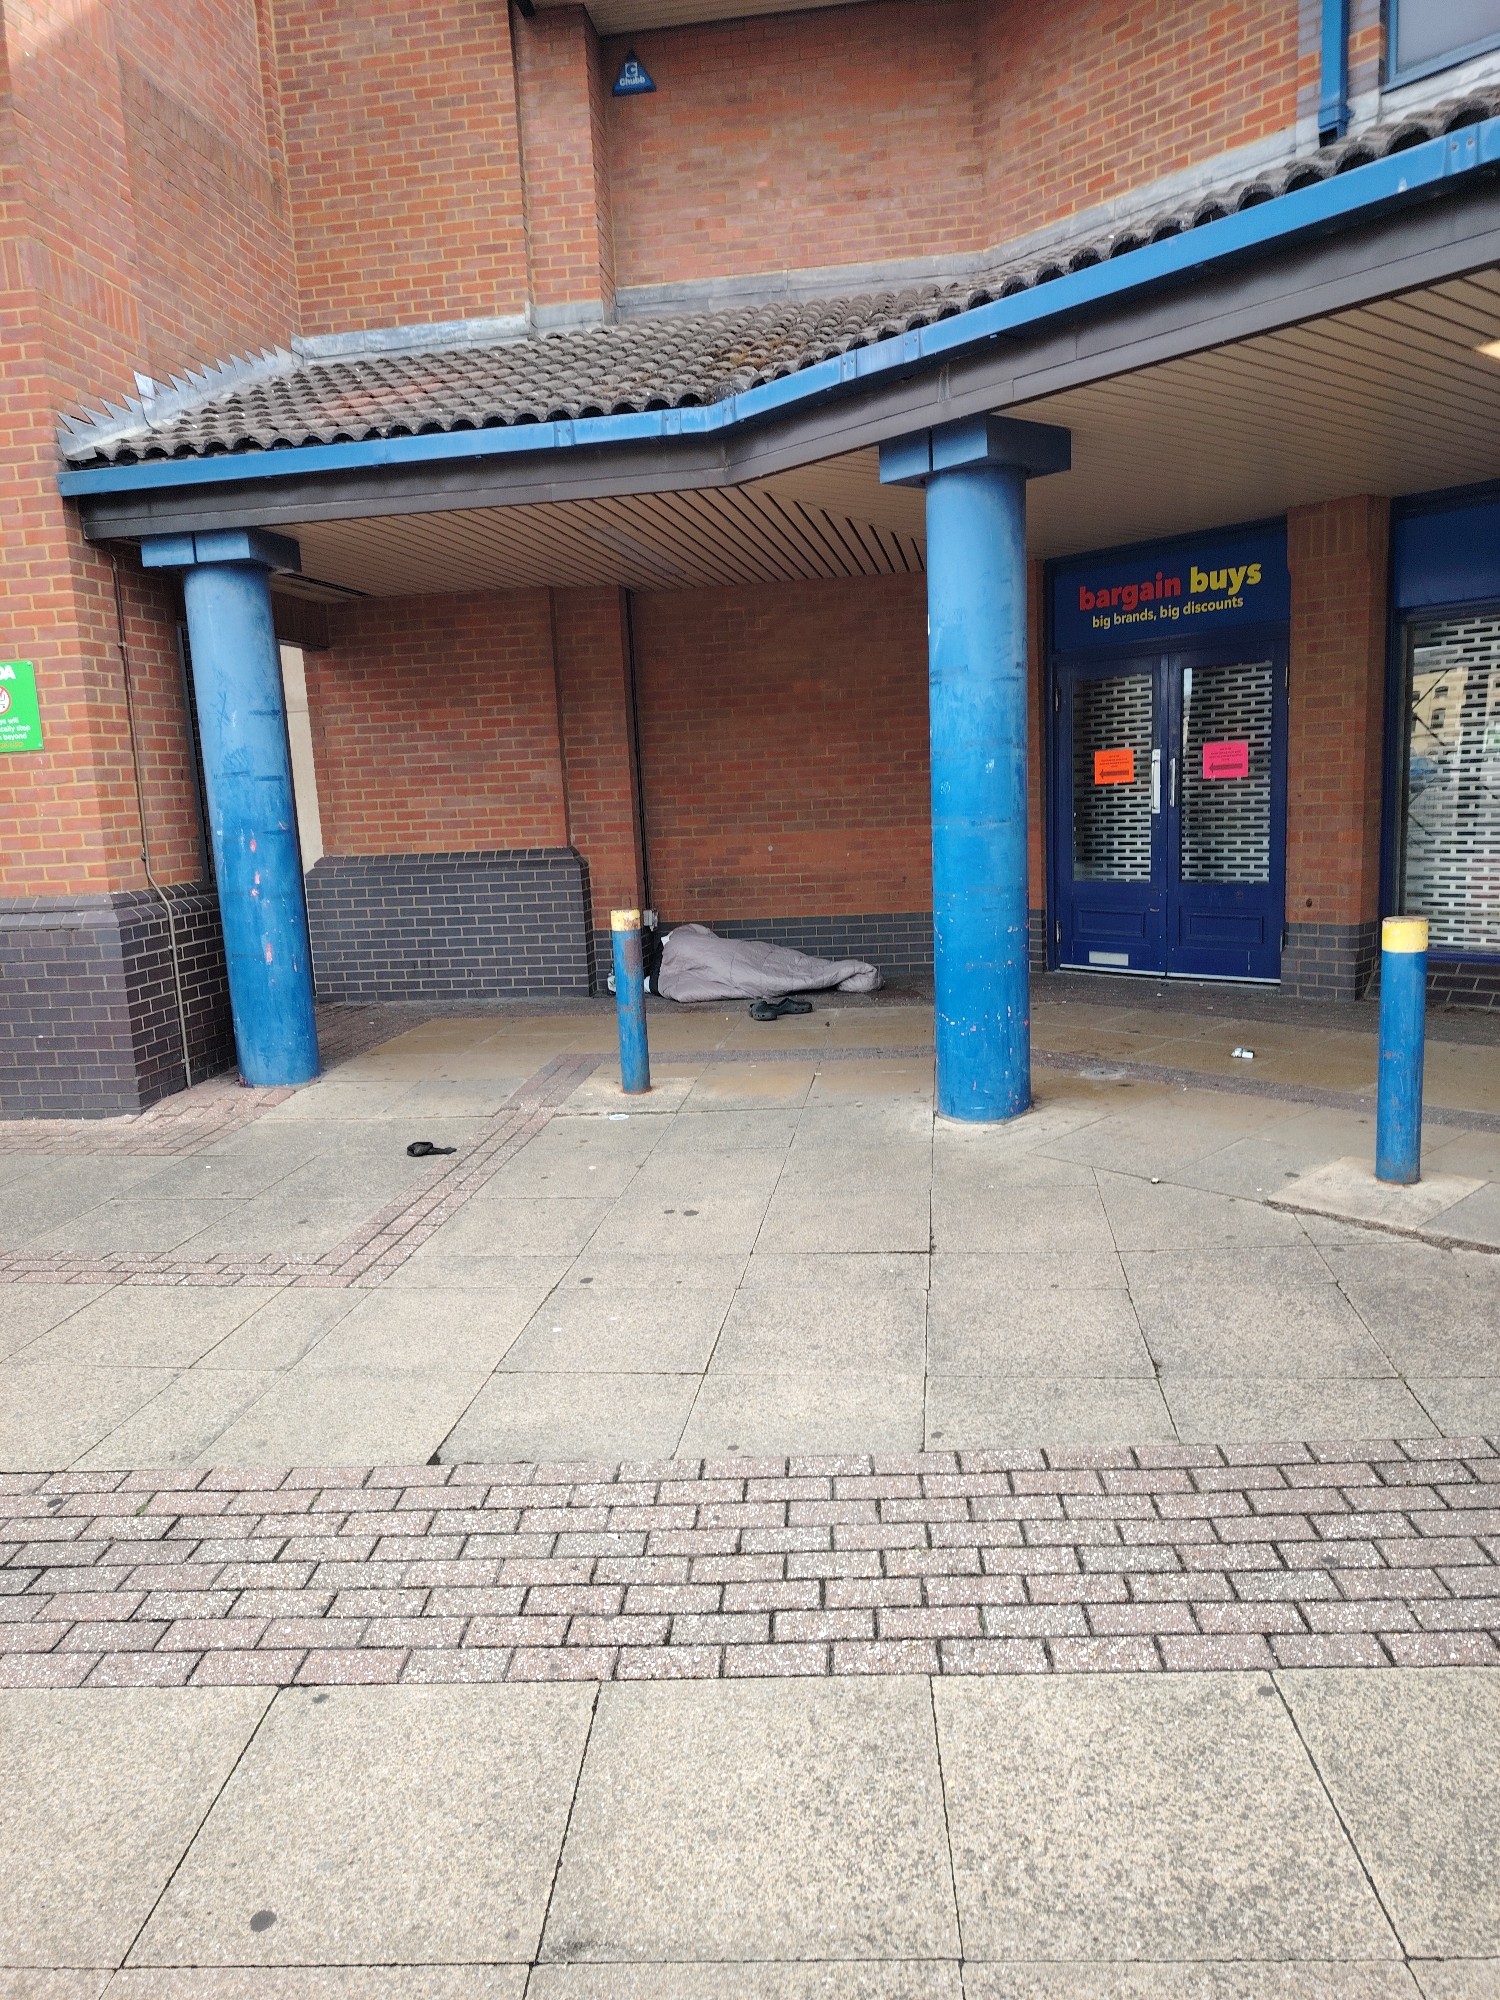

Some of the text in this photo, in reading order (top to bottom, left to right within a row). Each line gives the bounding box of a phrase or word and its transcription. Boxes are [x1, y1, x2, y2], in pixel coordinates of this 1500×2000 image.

[619, 75, 646, 86] Chubb
[1079, 562, 1263, 611] bargain buys
[1092, 596, 1244, 630] big brands, big discounts
[16, 725, 31, 733] stop
[3, 732, 27, 741] beyond
